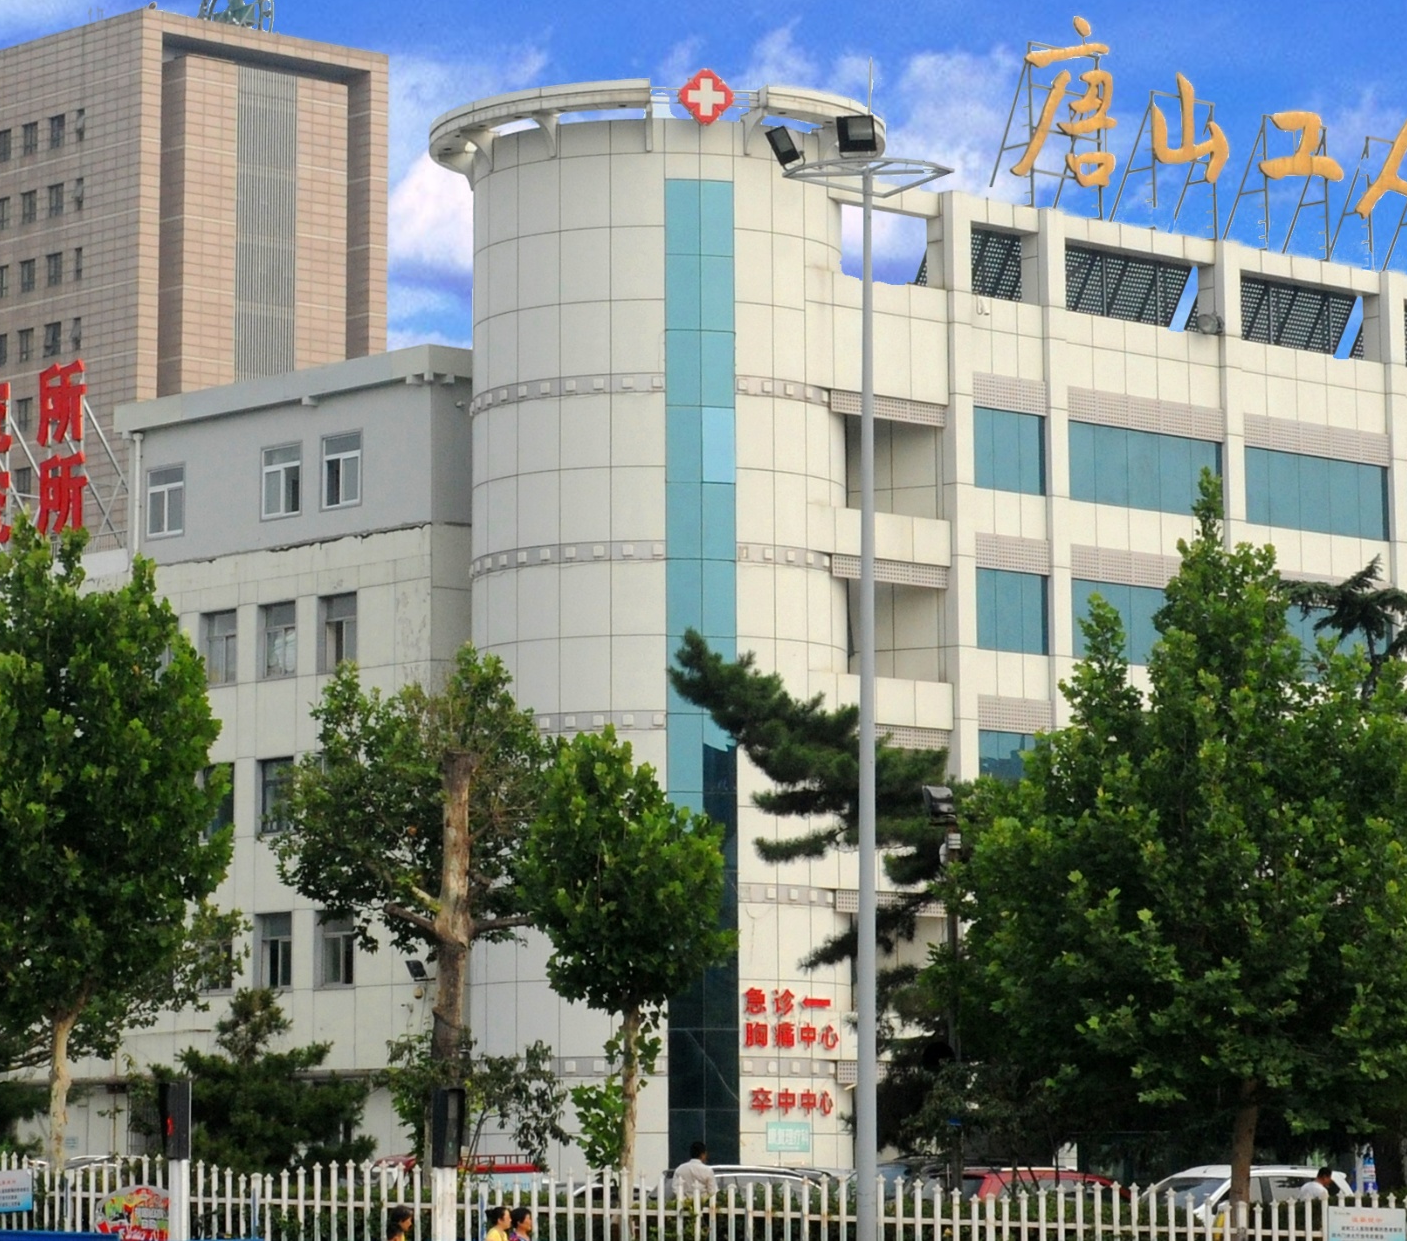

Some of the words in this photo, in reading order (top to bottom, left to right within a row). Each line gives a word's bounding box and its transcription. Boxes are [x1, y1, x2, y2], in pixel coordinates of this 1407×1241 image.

[745, 987, 796, 1016] 急诊
[745, 1021, 840, 1051] 胸痛中心
[750, 1086, 834, 1117] 卒中中心
